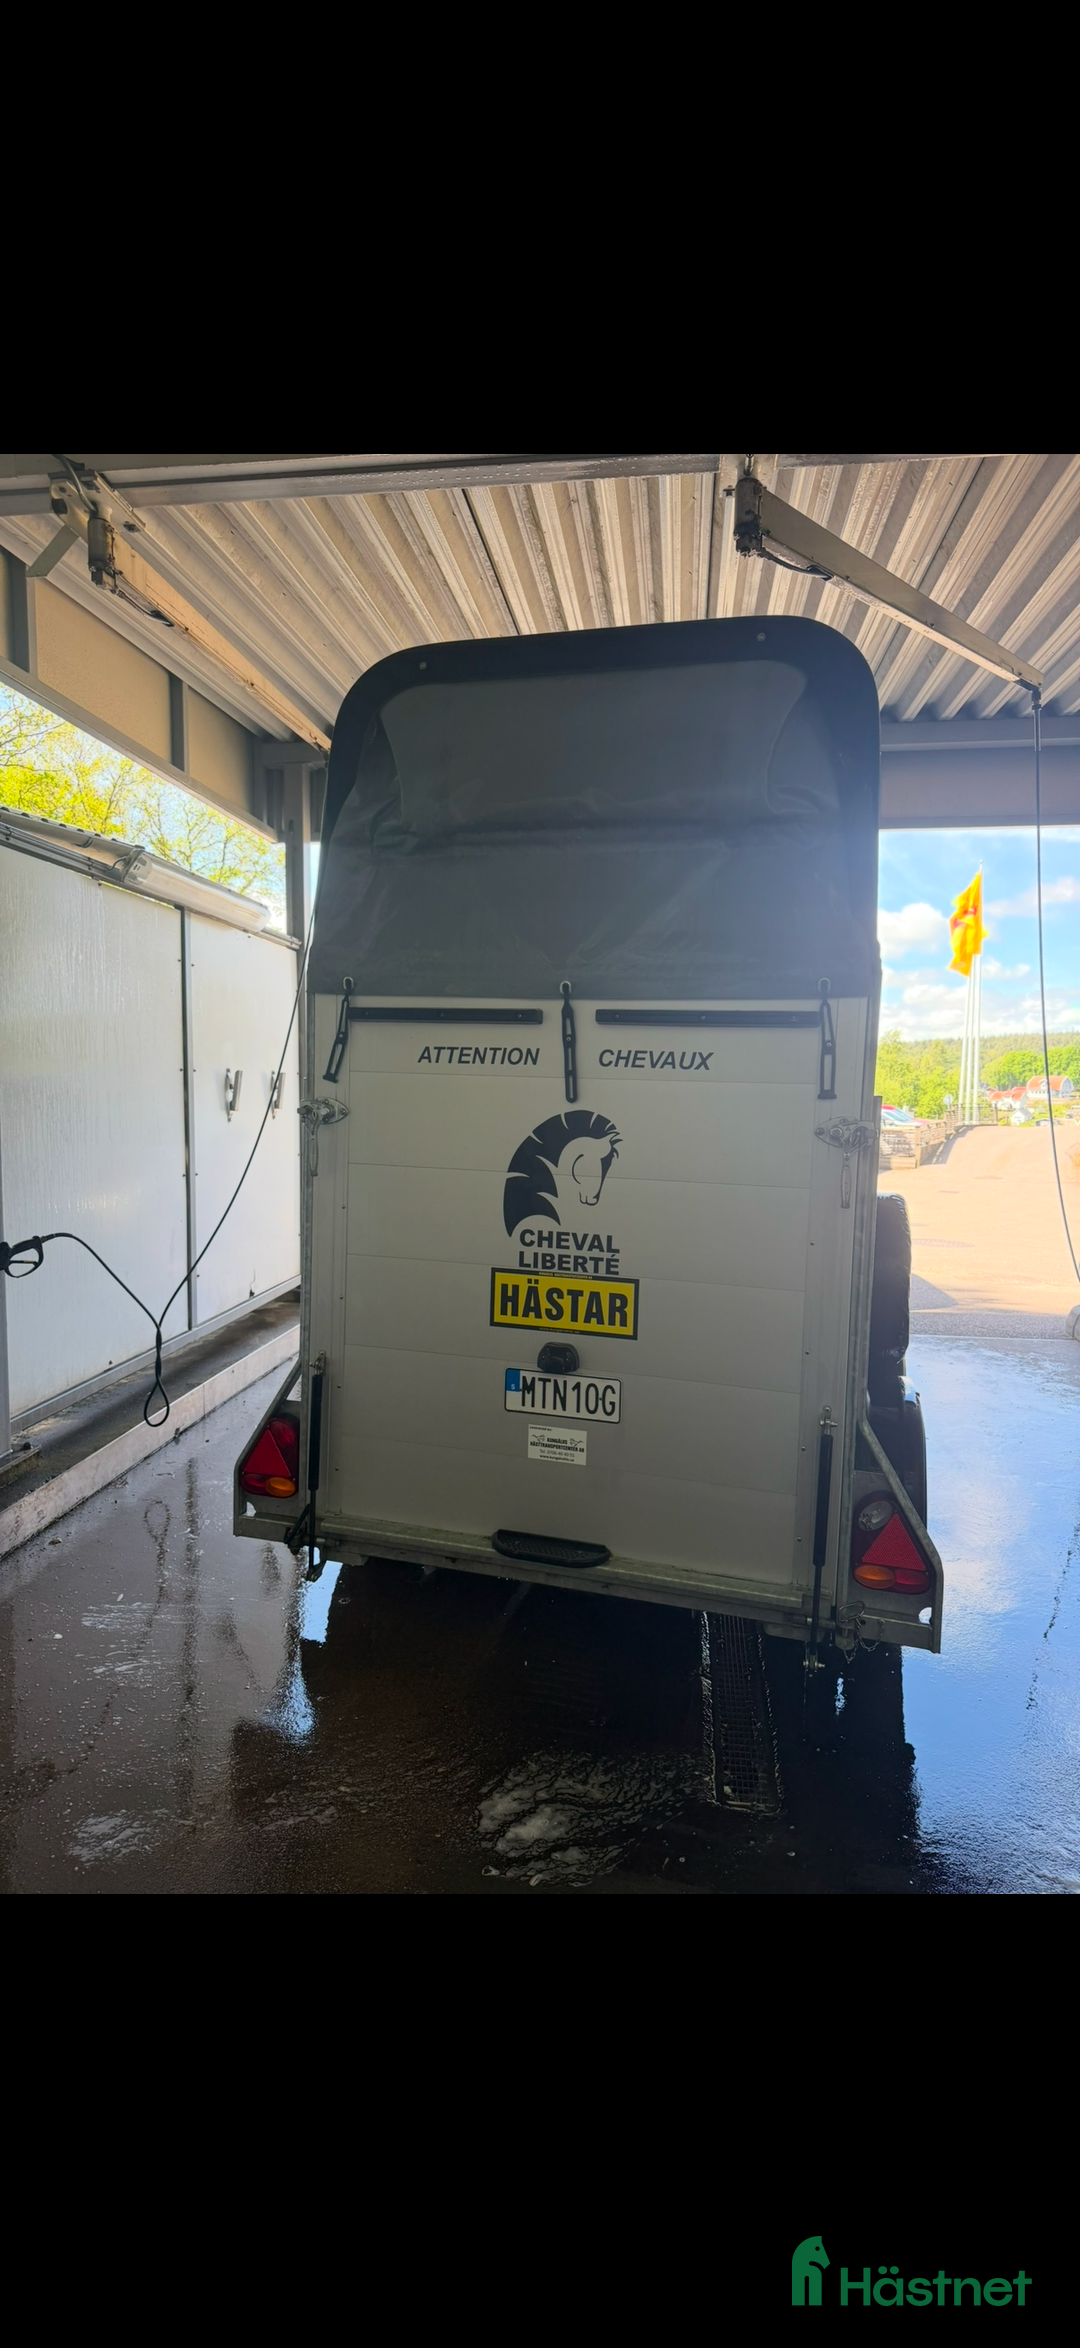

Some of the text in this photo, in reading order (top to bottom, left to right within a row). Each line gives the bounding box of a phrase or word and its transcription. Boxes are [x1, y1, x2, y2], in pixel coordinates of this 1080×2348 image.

[418, 1046, 714, 1071] ATTENTION CHEVAUX
[519, 1228, 620, 1254] CHEVAL
[518, 1250, 620, 1276] LIBERTÉ
[500, 1278, 629, 1328] HÄSTAR
